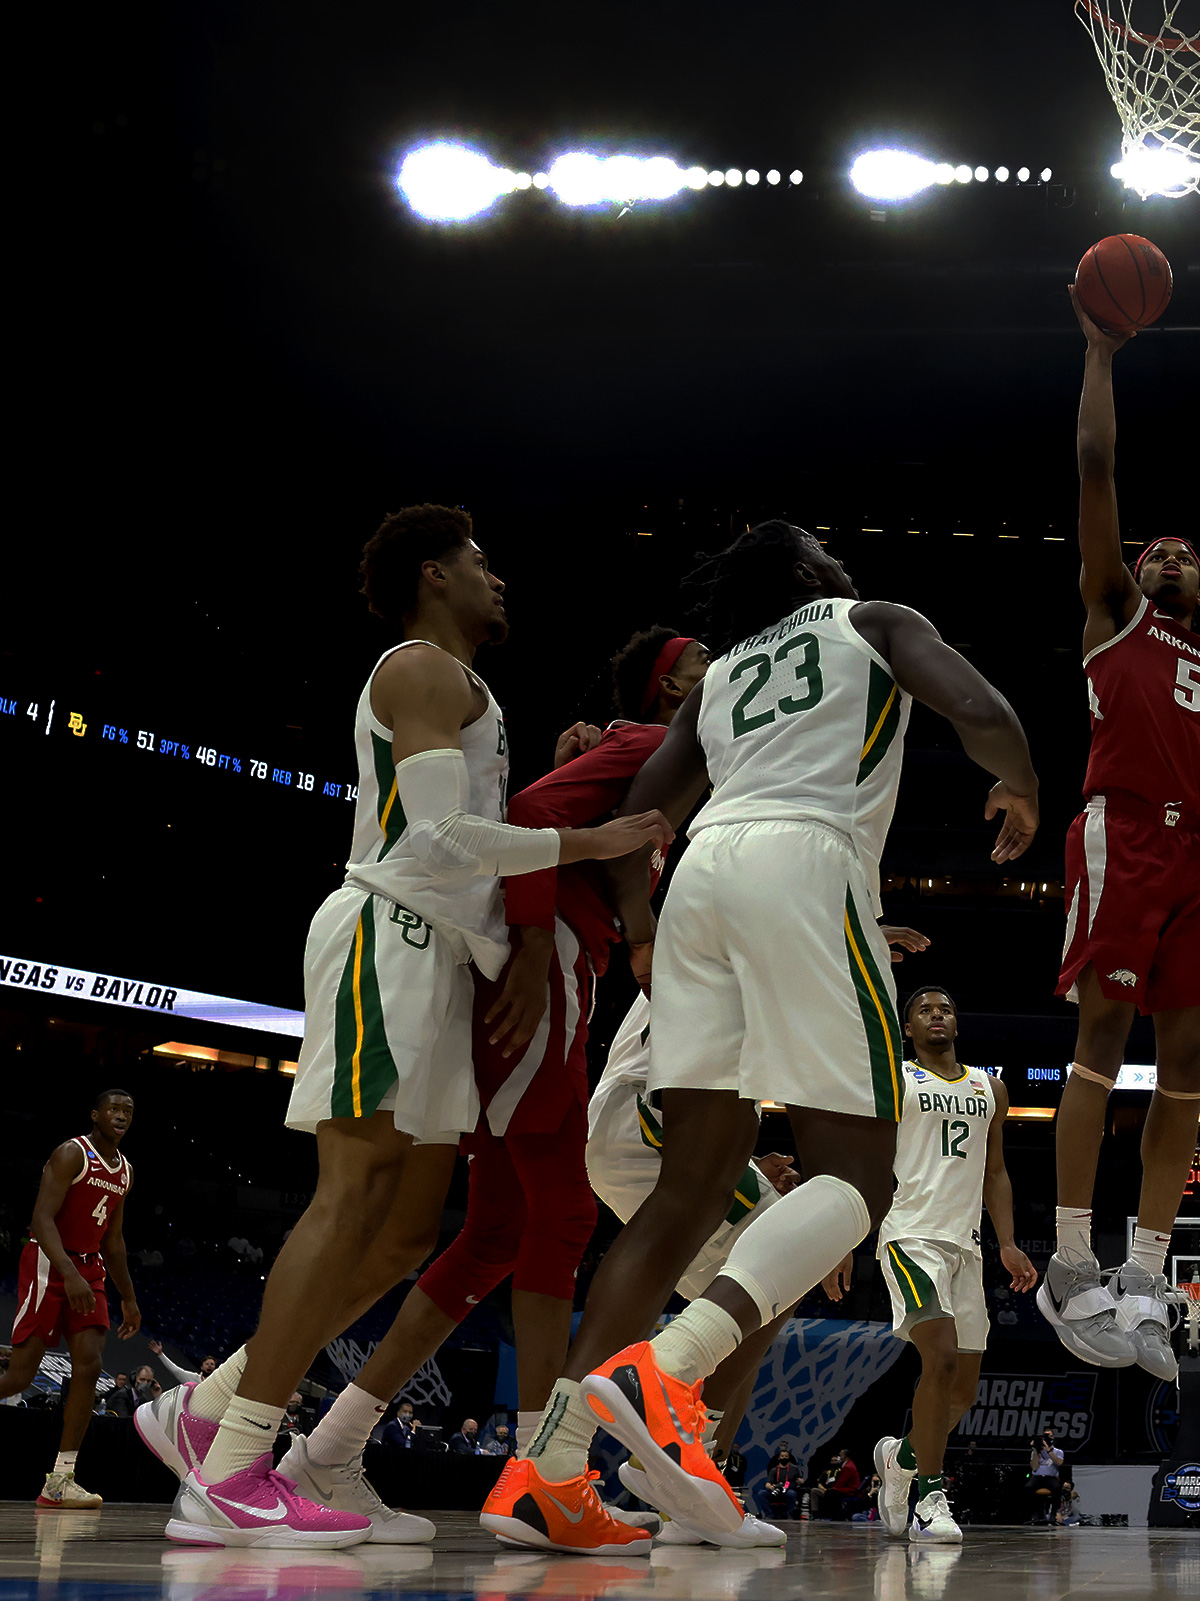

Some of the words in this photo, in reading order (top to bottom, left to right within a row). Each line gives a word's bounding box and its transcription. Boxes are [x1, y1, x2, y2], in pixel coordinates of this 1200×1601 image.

[728, 632, 824, 739] 23
[26, 702, 39, 721] 4
[102, 724, 116, 741] FG
[118, 729, 129, 744] %
[136, 731, 155, 752] 51
[159, 739, 180, 757] 3PT
[180, 745, 190, 760] %
[195, 746, 217, 767] 46
[218, 754, 231, 770] FT
[232, 758, 242, 773] %
[249, 759, 268, 780] 78
[272, 768, 292, 785] REB
[296, 772, 315, 792] 18
[322, 782, 342, 798] AST
[90, 976, 178, 1011] BAYLOR
[1027, 1068, 1061, 1081] BONUS
[918, 1092, 988, 1119] BAYLOR
[941, 1119, 970, 1160] 12
[86, 1176, 126, 1196] ARKANSAS
[91, 1194, 109, 1226] 4
[975, 1380, 1045, 1407] ARCH
[957, 1409, 1089, 1439] MADNESS
